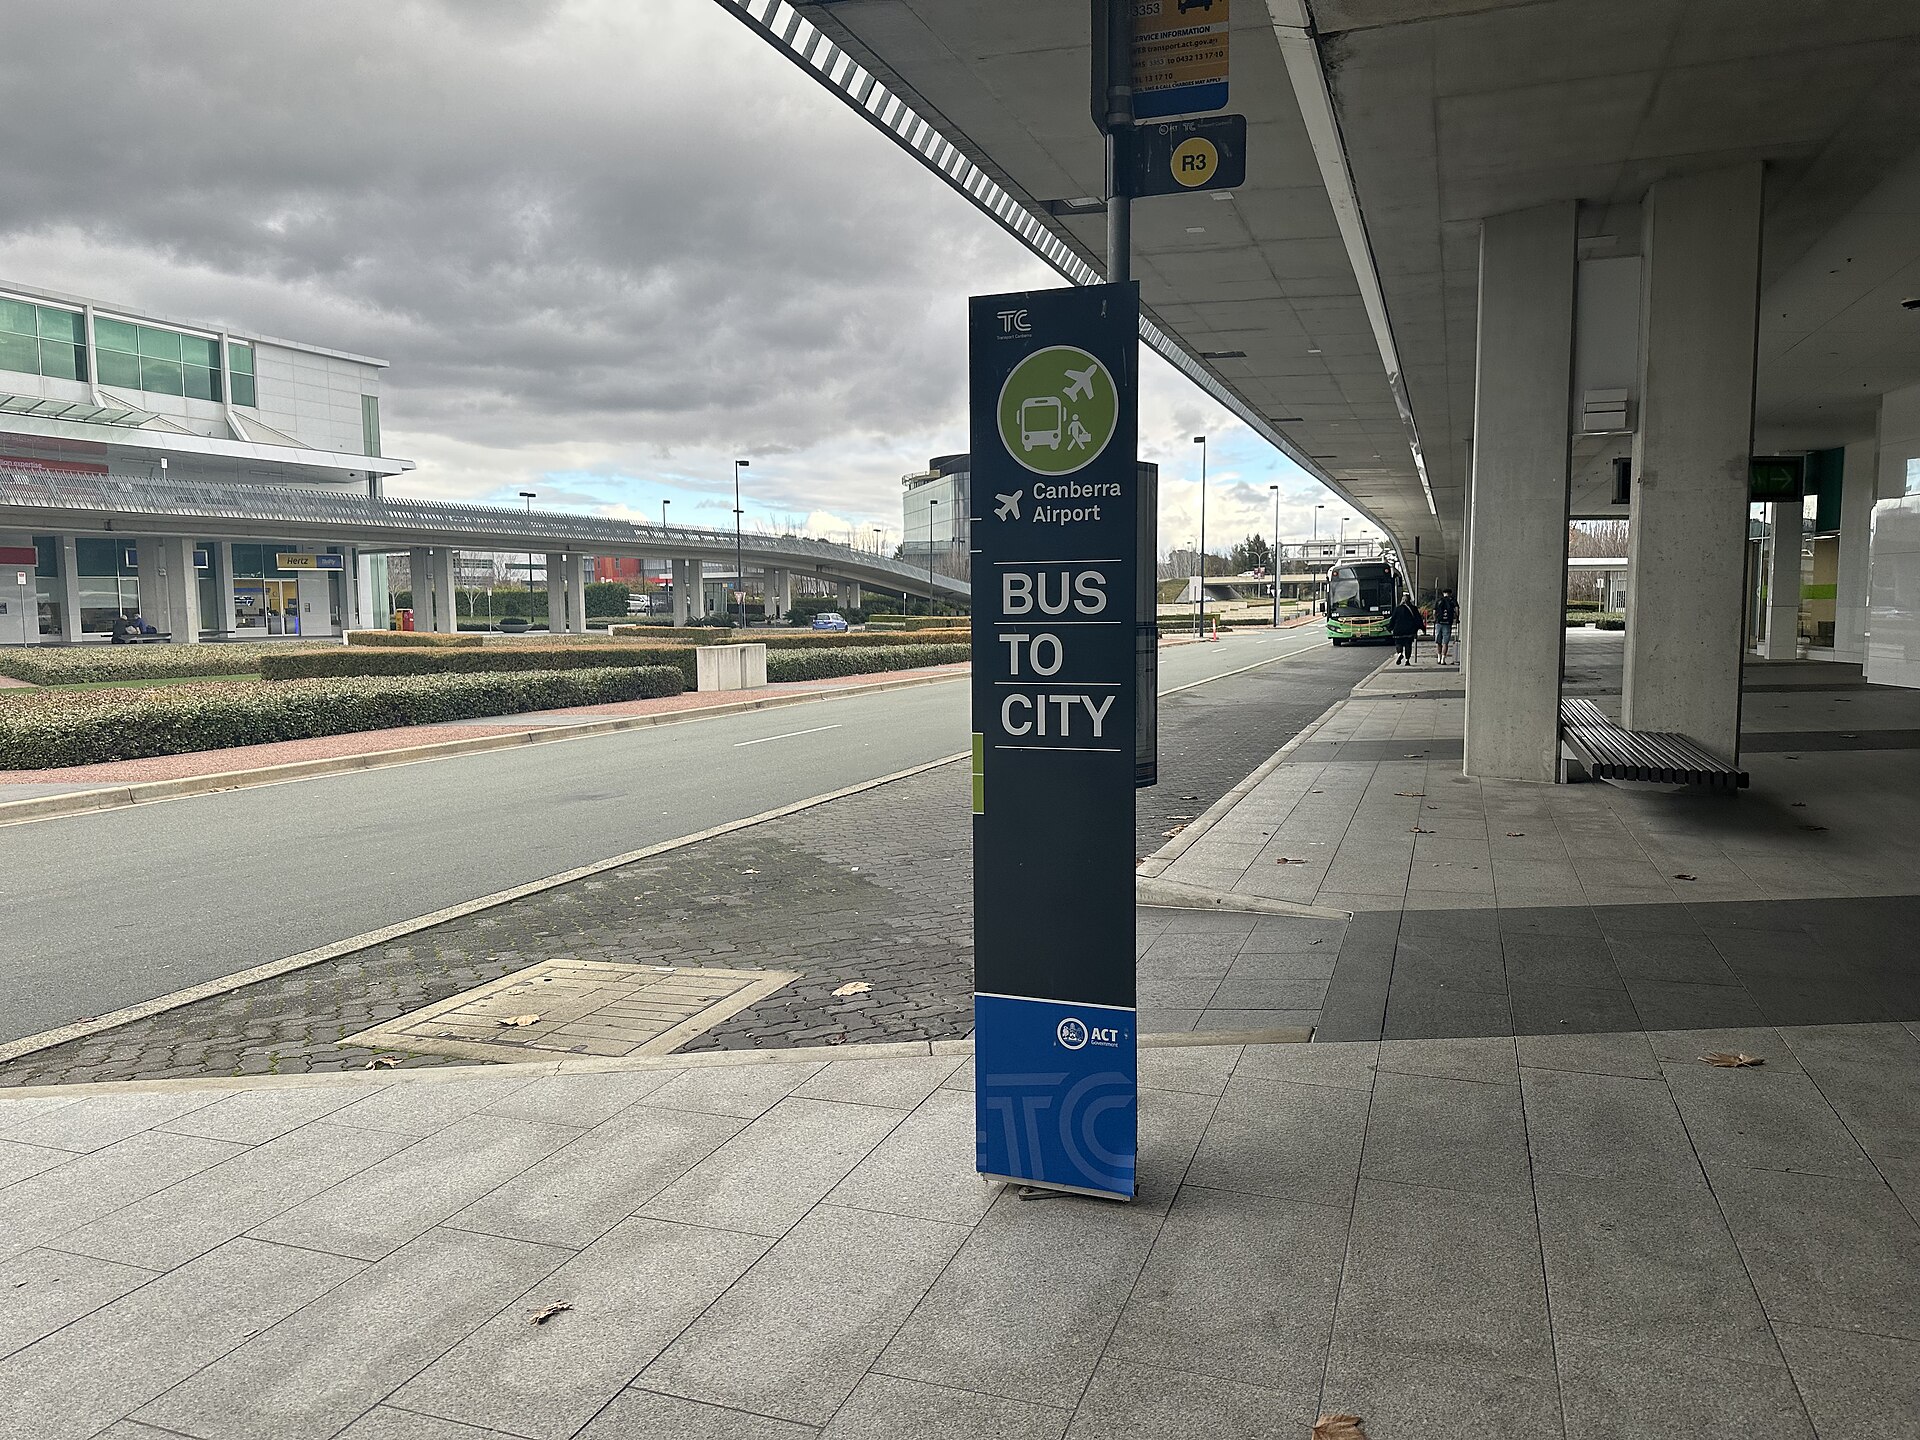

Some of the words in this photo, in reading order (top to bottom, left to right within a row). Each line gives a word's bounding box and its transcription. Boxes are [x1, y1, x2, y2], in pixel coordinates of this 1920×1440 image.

[1135, 33, 1159, 42] ERVICE
[1160, 26, 1210, 39] INFORMATION
[1181, 154, 1207, 171] R3
[996, 309, 1032, 333] TC
[1033, 481, 1122, 500] Canberra
[1033, 505, 1101, 526] Airport
[287, 557, 309, 565] Hertz
[1002, 570, 1107, 615] BUS
[999, 633, 1064, 676] TO
[1001, 693, 1116, 738] CITY
[1091, 1027, 1119, 1042] ACT
